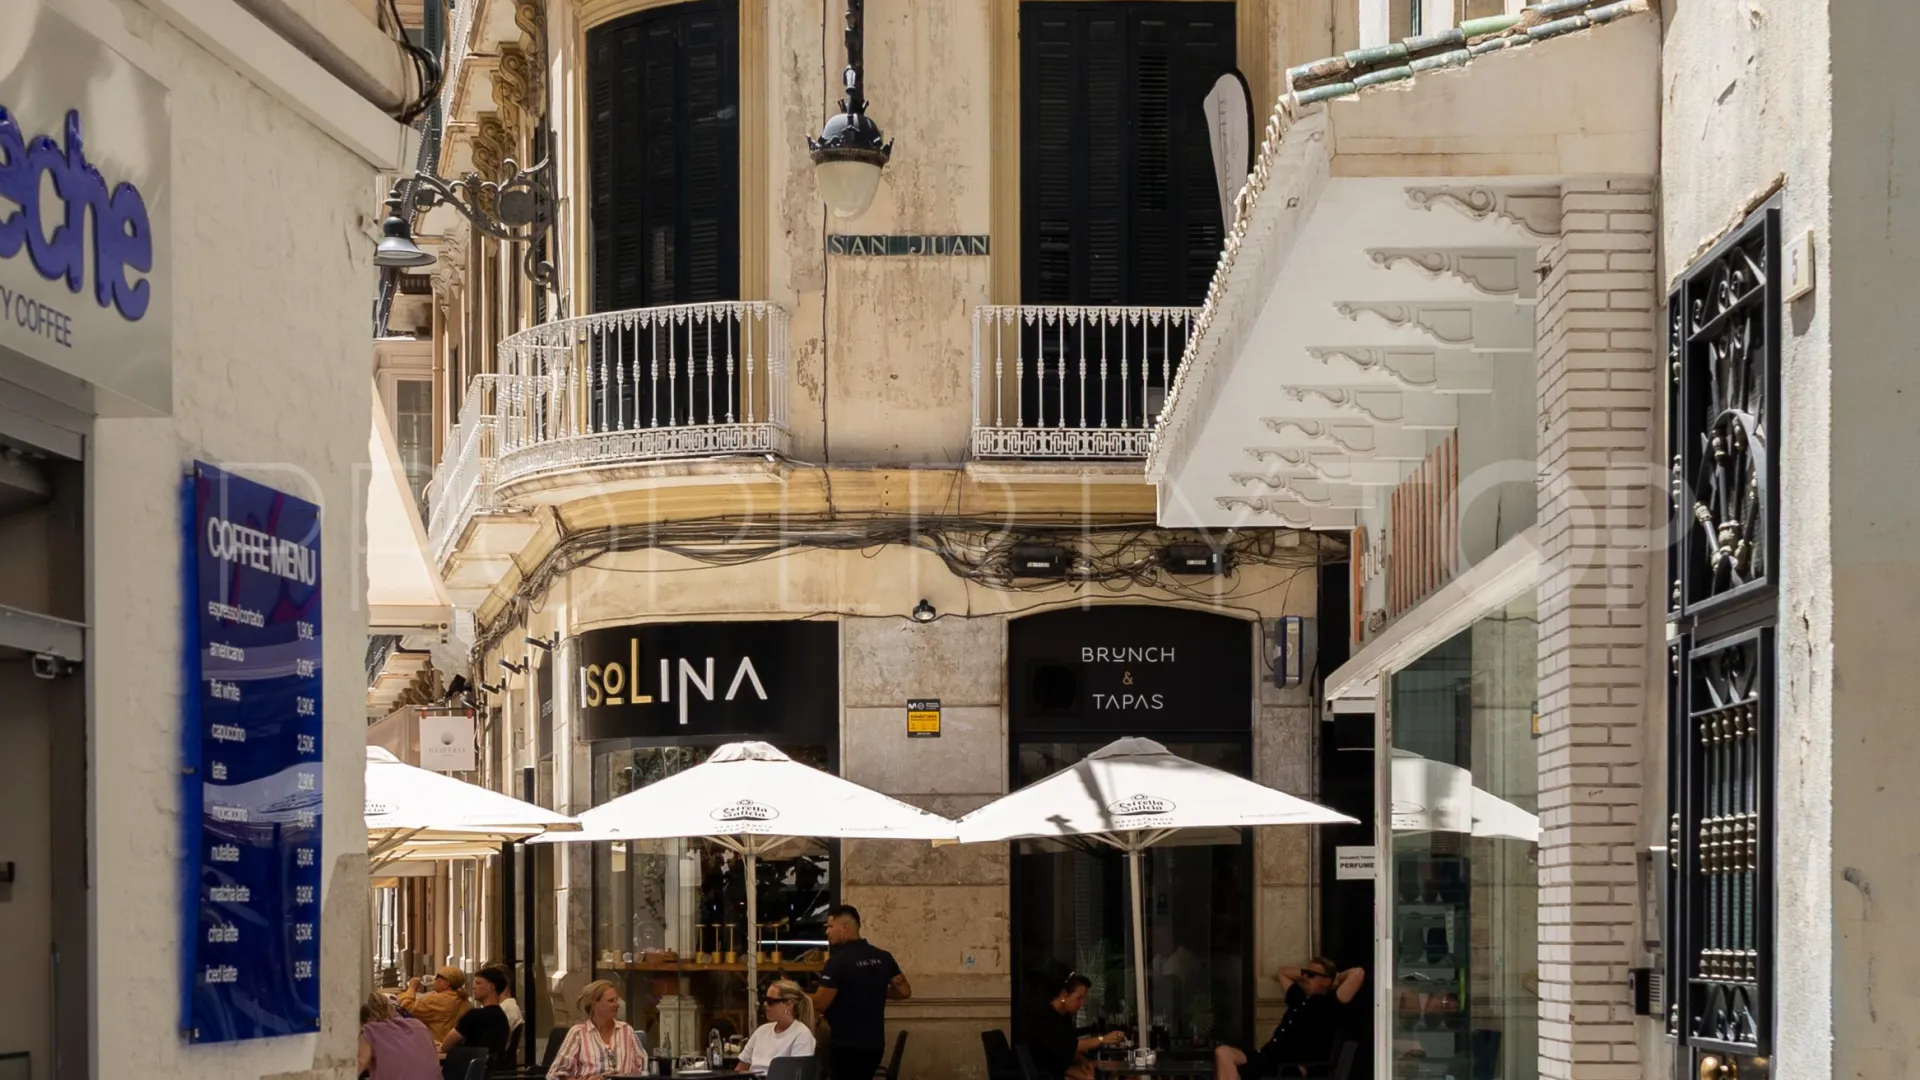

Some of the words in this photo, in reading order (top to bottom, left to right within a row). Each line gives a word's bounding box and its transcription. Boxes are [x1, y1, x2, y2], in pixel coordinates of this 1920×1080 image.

[831, 235, 887, 257] SAN
[909, 235, 988, 257] JUAN
[15, 293, 72, 348] COFFEE
[207, 516, 270, 573] COFFEE
[270, 536, 316, 586] MENU
[209, 641, 245, 663] americano
[1081, 646, 1175, 663] BRUNCH
[1122, 671, 1134, 686] &
[211, 678, 222, 699] flat
[222, 682, 241, 703] white
[1092, 693, 1164, 710] TAPAS
[212, 760, 228, 781] latte
[210, 886, 236, 902] matcha
[236, 885, 250, 902] latte
[205, 964, 223, 983] iced
[223, 964, 238, 983] latte
